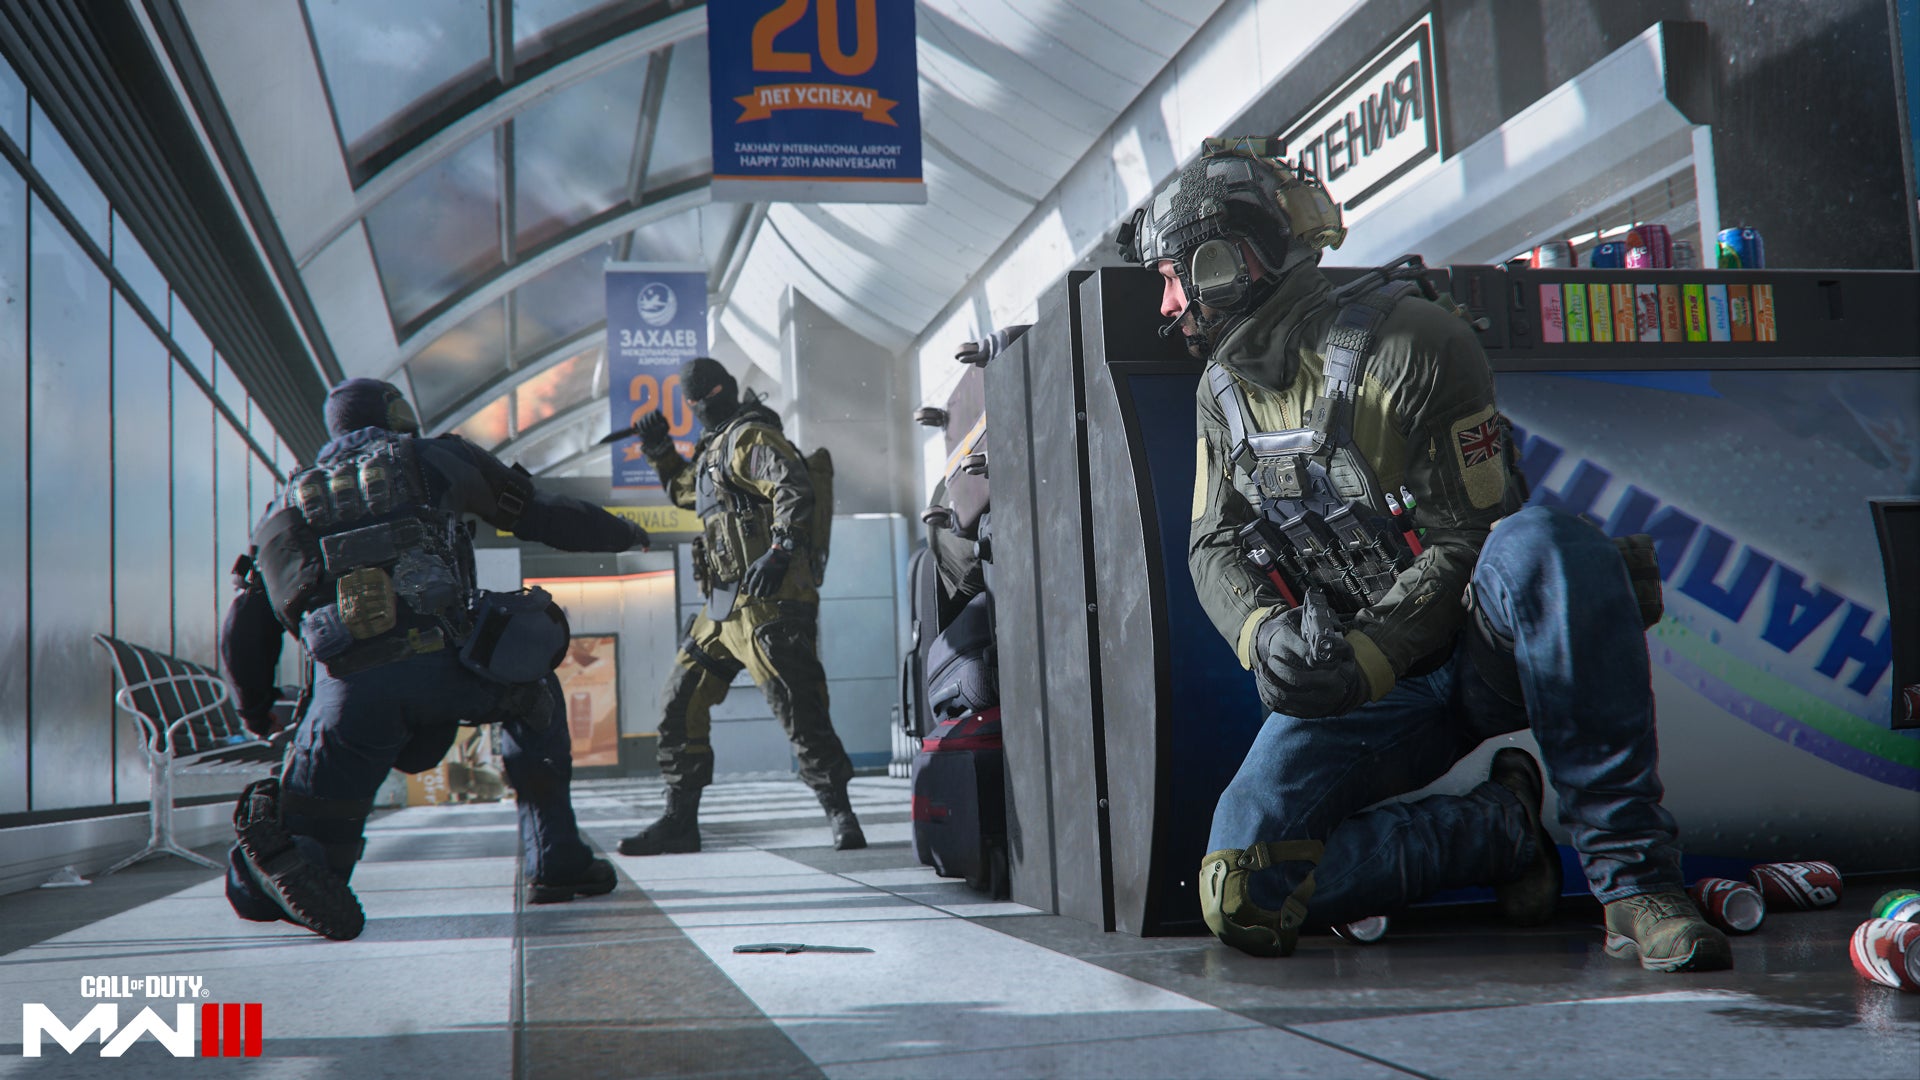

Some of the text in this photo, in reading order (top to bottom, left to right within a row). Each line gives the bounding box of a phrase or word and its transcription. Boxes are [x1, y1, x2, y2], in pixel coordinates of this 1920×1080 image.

[752, 0, 878, 76] 20
[759, 87, 873, 109] ЛЕТ УСПЕХА!
[734, 142, 902, 155] ZAKHAEV INTERNATIONAL AIRPORT
[739, 155, 897, 169] HAPPY 20TH ANNIVERSARY!
[620, 329, 698, 347] ЗАХАЕВ
[630, 374, 694, 437] 20
